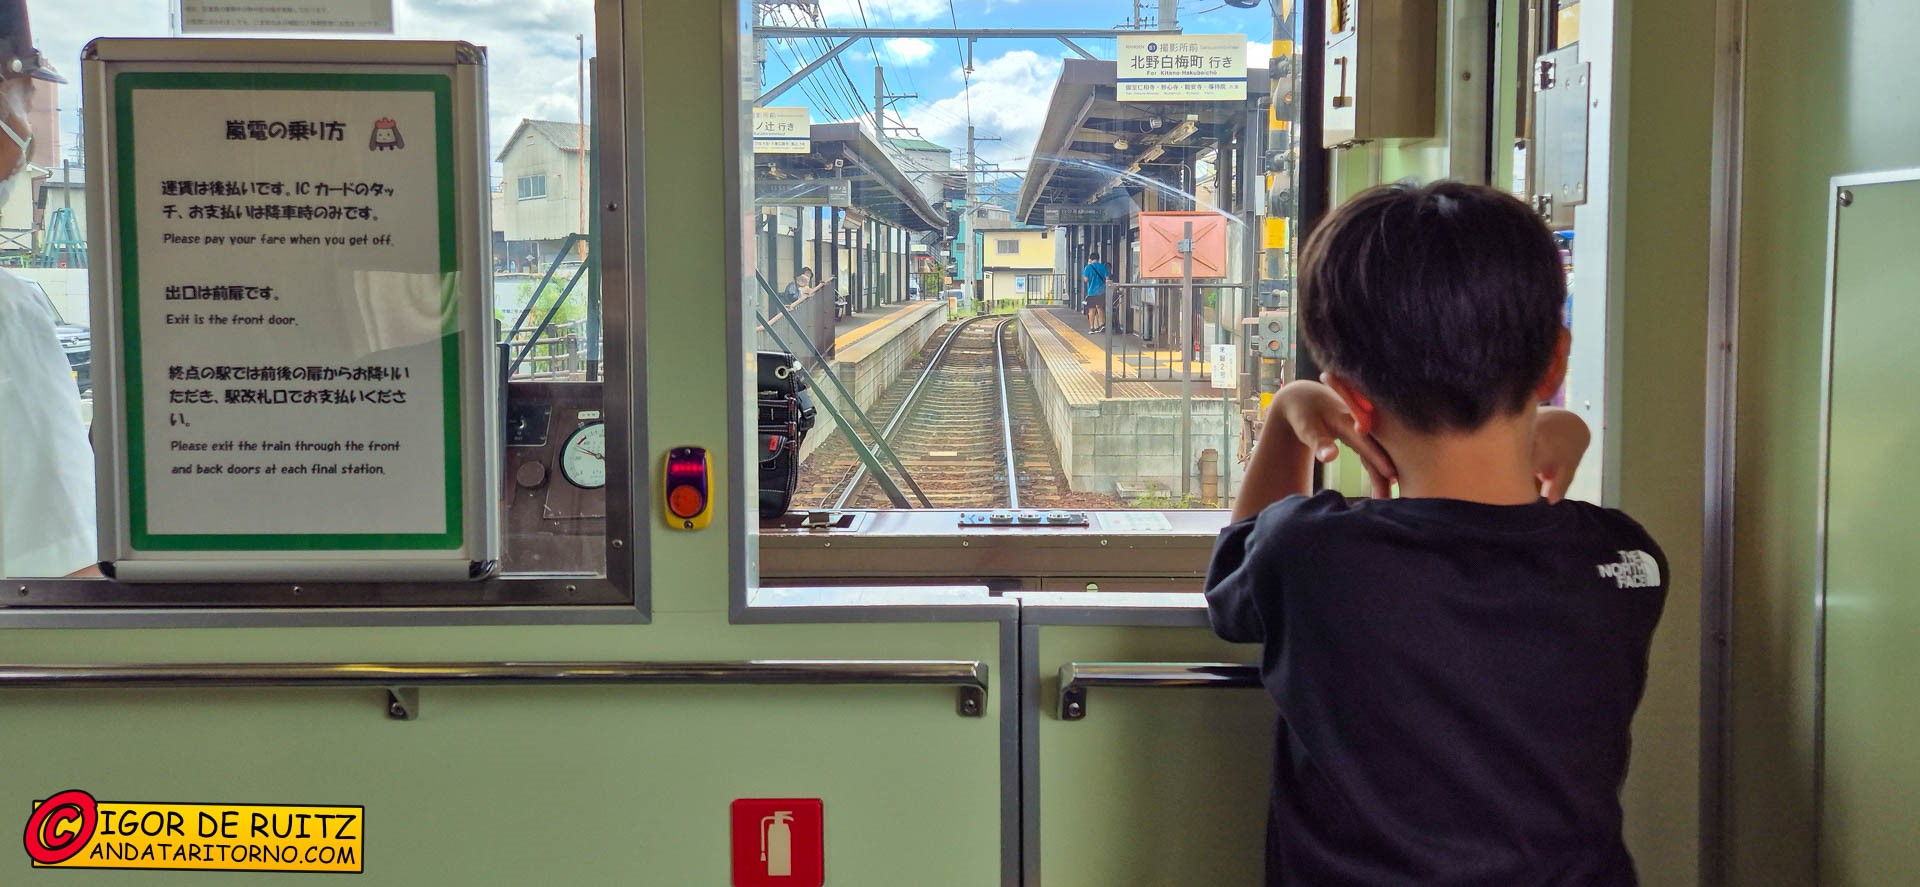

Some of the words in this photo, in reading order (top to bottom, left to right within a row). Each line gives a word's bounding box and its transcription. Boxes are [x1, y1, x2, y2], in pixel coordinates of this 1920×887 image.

[1131, 55, 1204, 69] 北野白梅町
[1209, 56, 1232, 69] 行き
[226, 120, 346, 141] 嵐電の乗り方
[778, 122, 794, 131] 行き
[315, 182, 394, 196] カードのタッ
[163, 204, 379, 220] チ、お支払いは降車時のみです。
[164, 233, 200, 243] Please
[205, 236, 225, 245] pay
[229, 236, 256, 245] your
[261, 234, 286, 244] fare
[290, 234, 320, 244] when
[325, 237, 345, 246] you
[349, 234, 368, 246] get
[373, 235, 394, 246] off.
[166, 285, 280, 300] 出口は前扉です。
[166, 314, 189, 324] Exit
[194, 314, 204, 324] is
[208, 314, 228, 324] the
[232, 315, 264, 324] front
[268, 315, 298, 325] door.
[169, 366, 409, 381] 終点の駅では前後の扉からお降りい
[170, 389, 406, 404] ただき、駅改札口でお支払いくださ
[170, 413, 190, 427] い。
[171, 441, 208, 451] Please
[212, 441, 234, 451] exit
[238, 441, 257, 451] the
[262, 441, 291, 451] train
[295, 441, 341, 452] through
[345, 441, 364, 451] the
[368, 441, 400, 451] front
[172, 464, 192, 474] and
[197, 464, 223, 474] back
[227, 464, 261, 474] doors
[265, 464, 276, 474] at
[281, 464, 307, 474] each
[311, 464, 337, 474] final
[342, 464, 385, 475] station.
[1617, 550, 1641, 562] THE
[1596, 562, 1646, 578] NORTH
[1616, 576, 1647, 589] FACE
